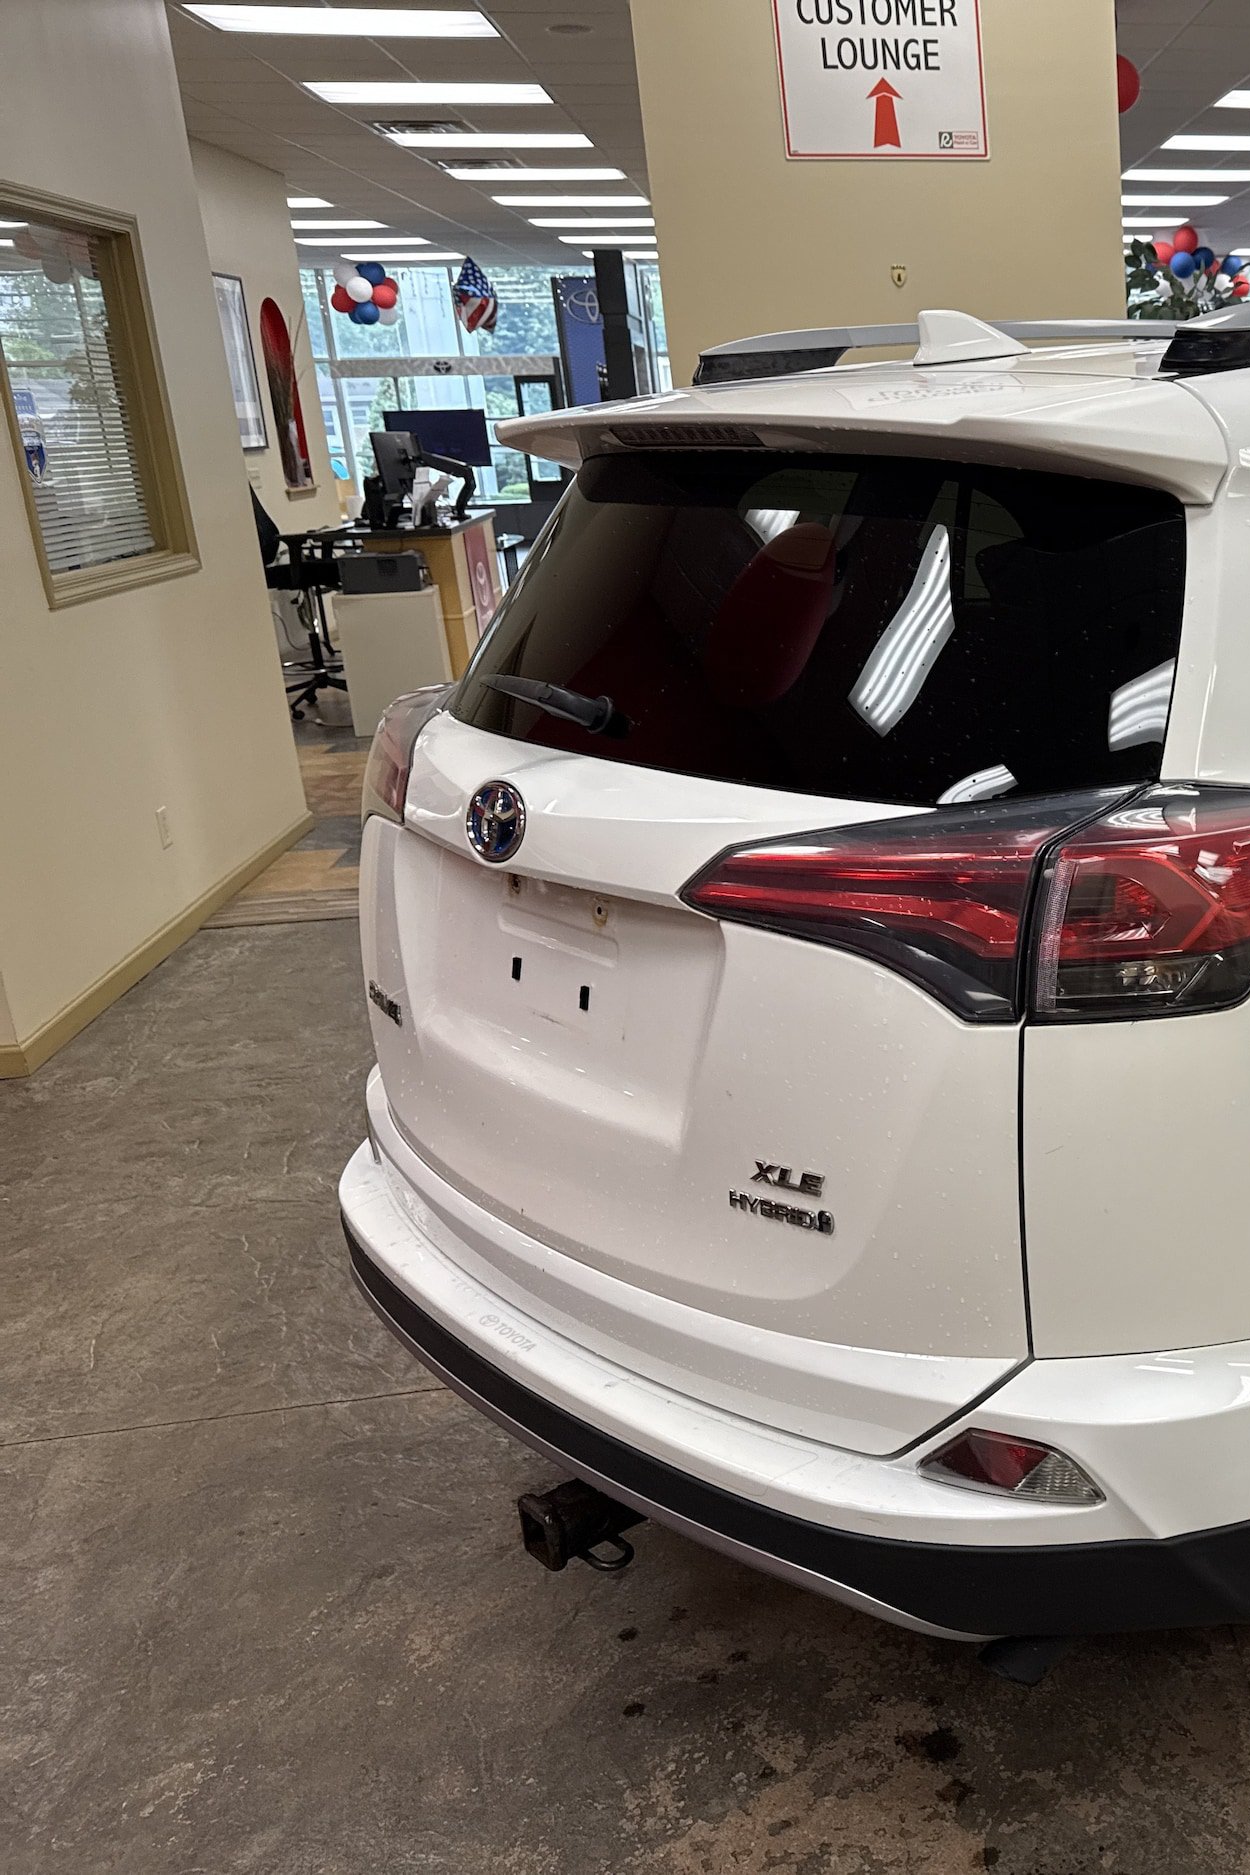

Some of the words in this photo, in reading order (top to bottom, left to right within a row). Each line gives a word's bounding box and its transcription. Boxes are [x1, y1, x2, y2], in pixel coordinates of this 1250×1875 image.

[796, 0, 958, 27] CUSTOMER
[820, 37, 941, 71] LOUNGE
[750, 1158, 825, 1198] XLE
[728, 1186, 818, 1231] HYBRID
[494, 1322, 537, 1352] TOYOTA
